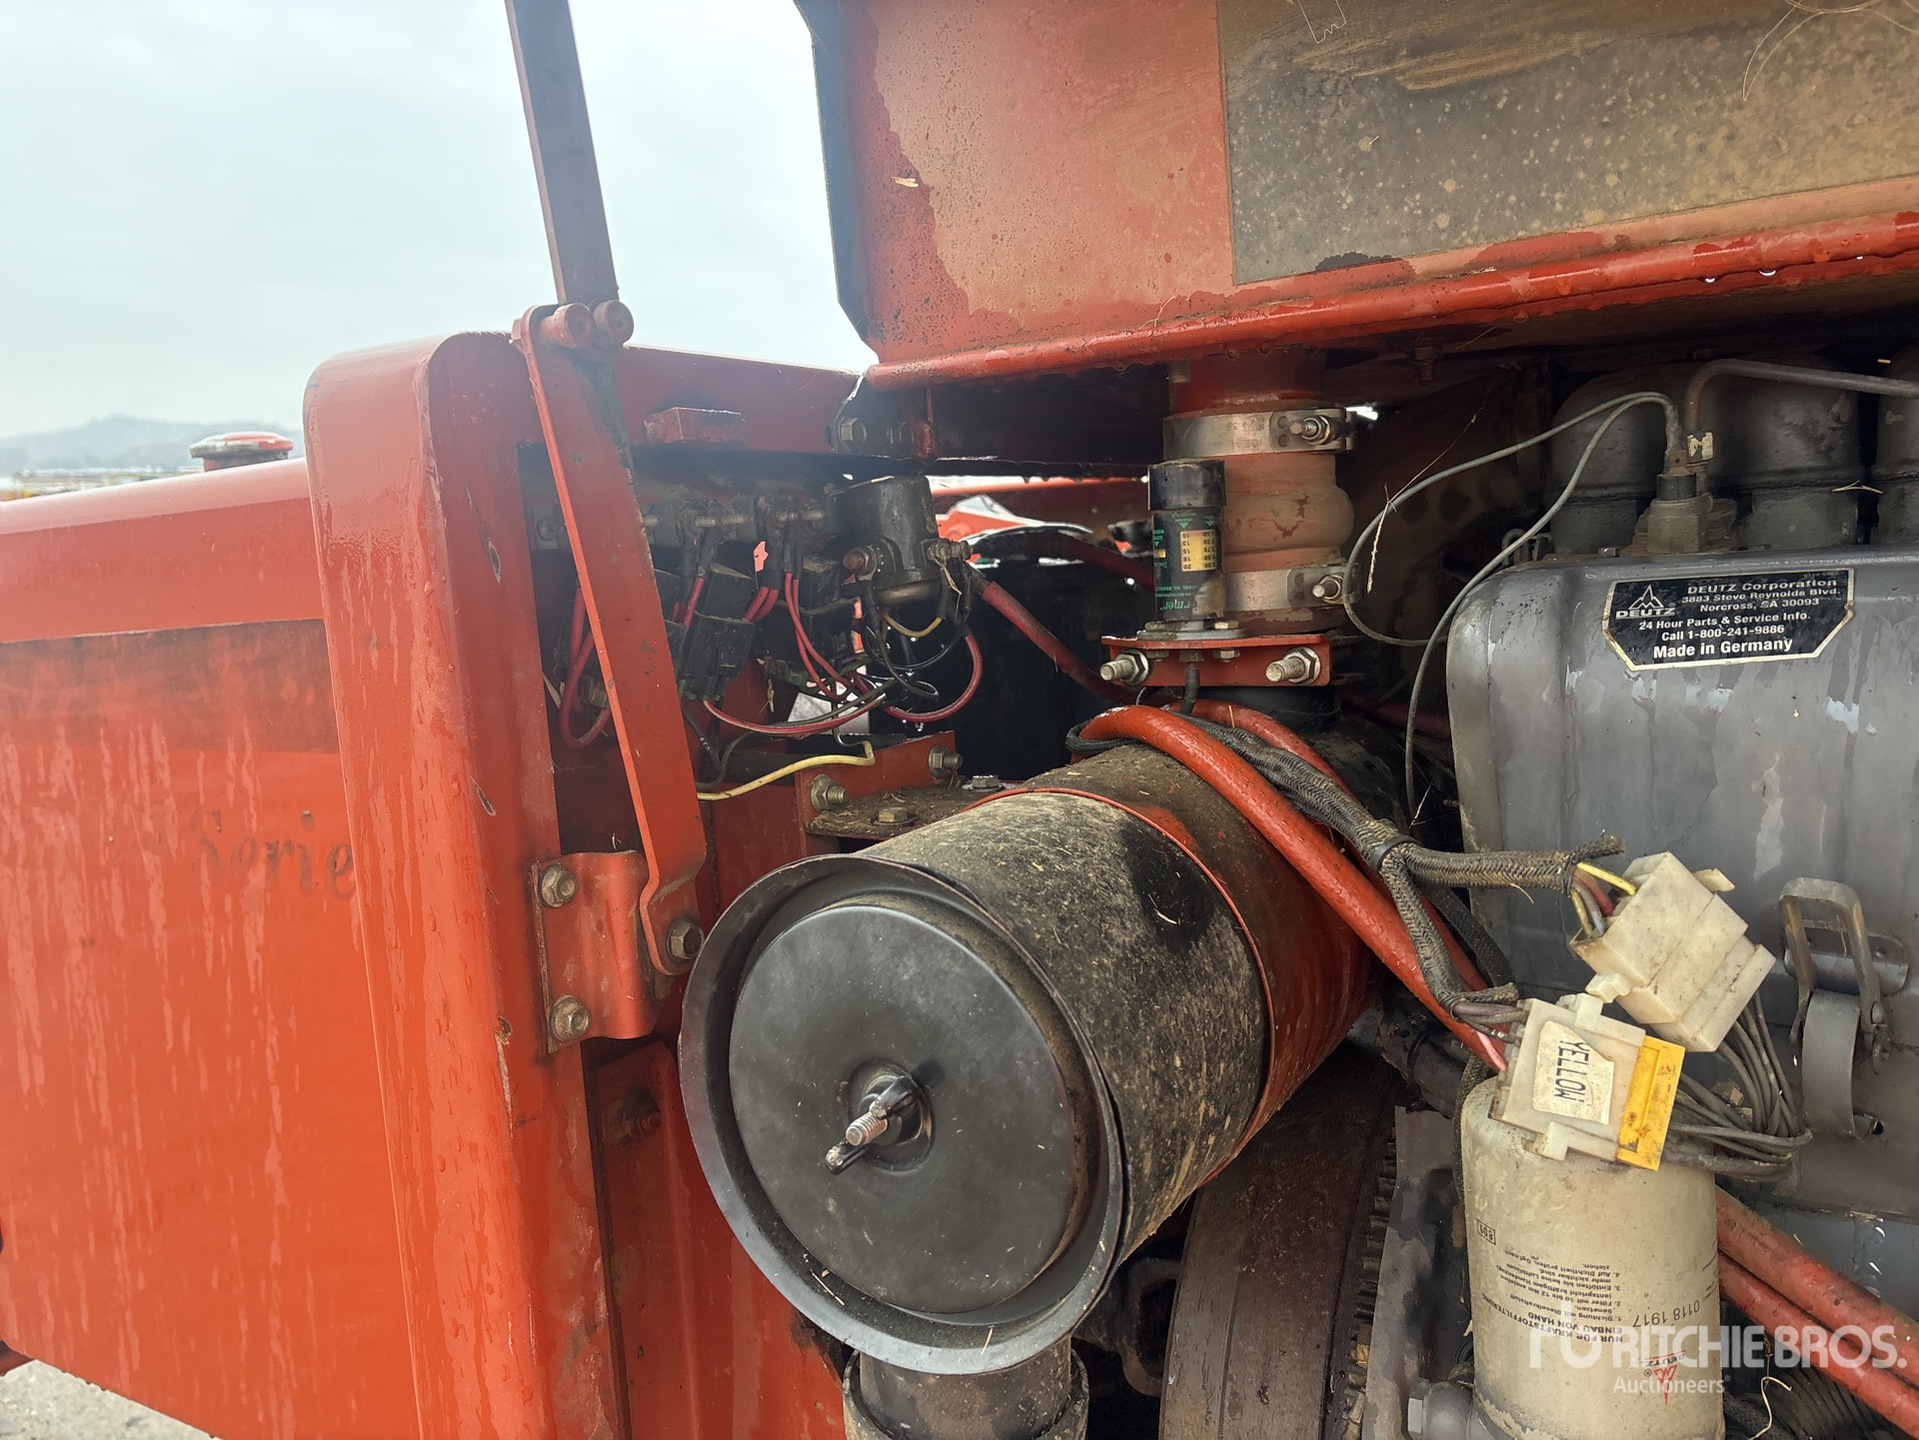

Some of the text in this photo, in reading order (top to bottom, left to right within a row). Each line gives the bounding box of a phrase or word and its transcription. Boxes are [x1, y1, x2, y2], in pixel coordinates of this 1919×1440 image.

[1687, 579, 1837, 595] DEUTZ Corporation
[1682, 588, 1841, 604] 3883 Steve Reynolds Blvd.
[1615, 607, 1676, 619] DEUTZ
[1700, 602, 1757, 613] Norcross,
[1782, 598, 1820, 607] 30093
[1639, 611, 1811, 631] 24 Hour Parts & Service Info.
[1662, 624, 1785, 641] Call 1-800-241-9886
[1653, 638, 1793, 659] Made in Germany
[1553, 1040, 1591, 1104] YELLOW
[1632, 1300, 1700, 1328] 0118 1917
[1528, 1312, 1622, 1334] EINBAU VON HAND
[1600, 1335, 1623, 1343] NUR
